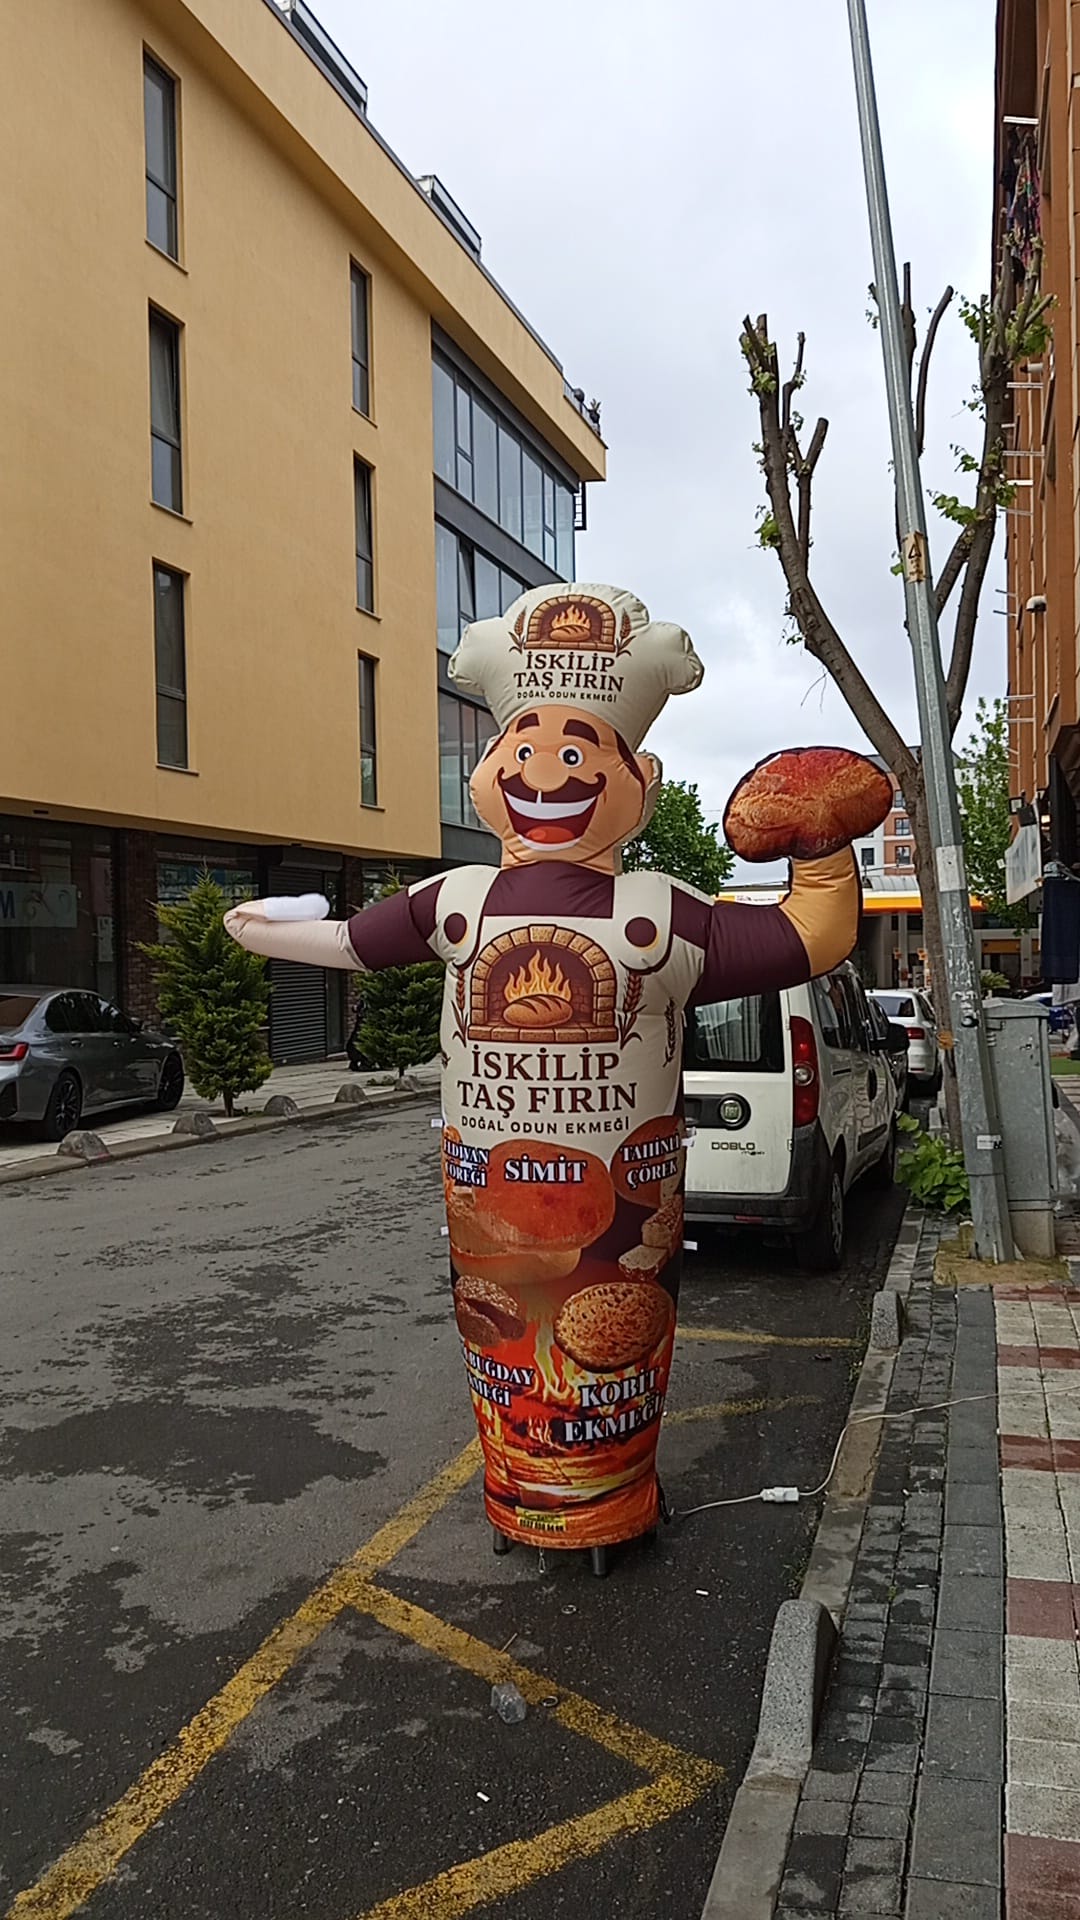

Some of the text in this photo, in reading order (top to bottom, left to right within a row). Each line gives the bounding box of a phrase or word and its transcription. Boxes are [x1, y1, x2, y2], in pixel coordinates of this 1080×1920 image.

[526, 651, 615, 672] İSKİLİP
[513, 672, 624, 692] TAŞ FIRIN
[517, 690, 617, 703] DOĞAL ODUN EKMEĞİ
[472, 1044, 619, 1081] İSKİLİP
[457, 1080, 637, 1118] TAŞ FIRIN
[461, 1115, 629, 1134] DOĞAL ODUN EKMEĞİ
[711, 1142, 755, 1151] DOBLO
[505, 1154, 587, 1182] SİMİT
[626, 1160, 677, 1189] ÇÖREK
[469, 1351, 534, 1386] BUĞDAY
